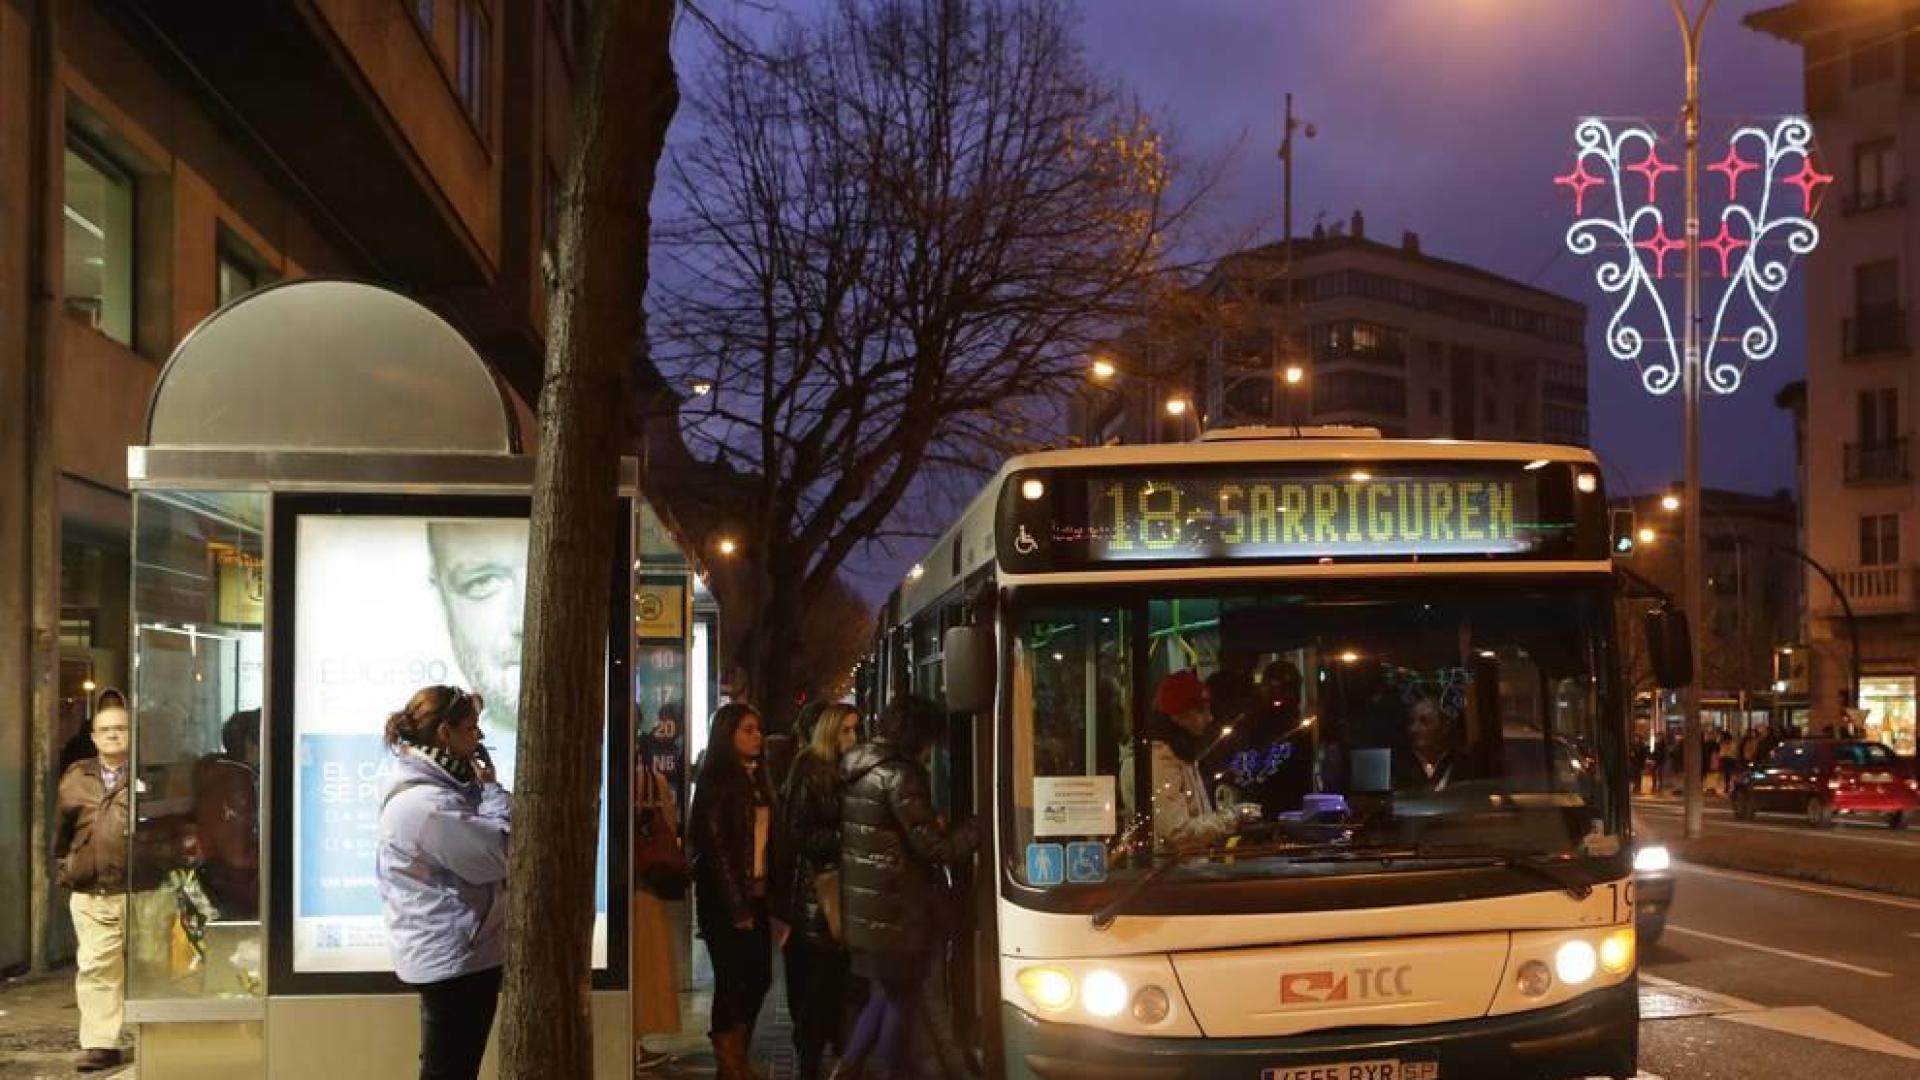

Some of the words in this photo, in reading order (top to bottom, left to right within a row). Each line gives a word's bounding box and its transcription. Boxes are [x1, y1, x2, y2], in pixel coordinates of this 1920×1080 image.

[655, 684, 674, 703] 17
[654, 719, 675, 738] 20
[323, 761, 352, 782] EL
[322, 782, 352, 803] SE
[1354, 965, 1413, 999] TCC
